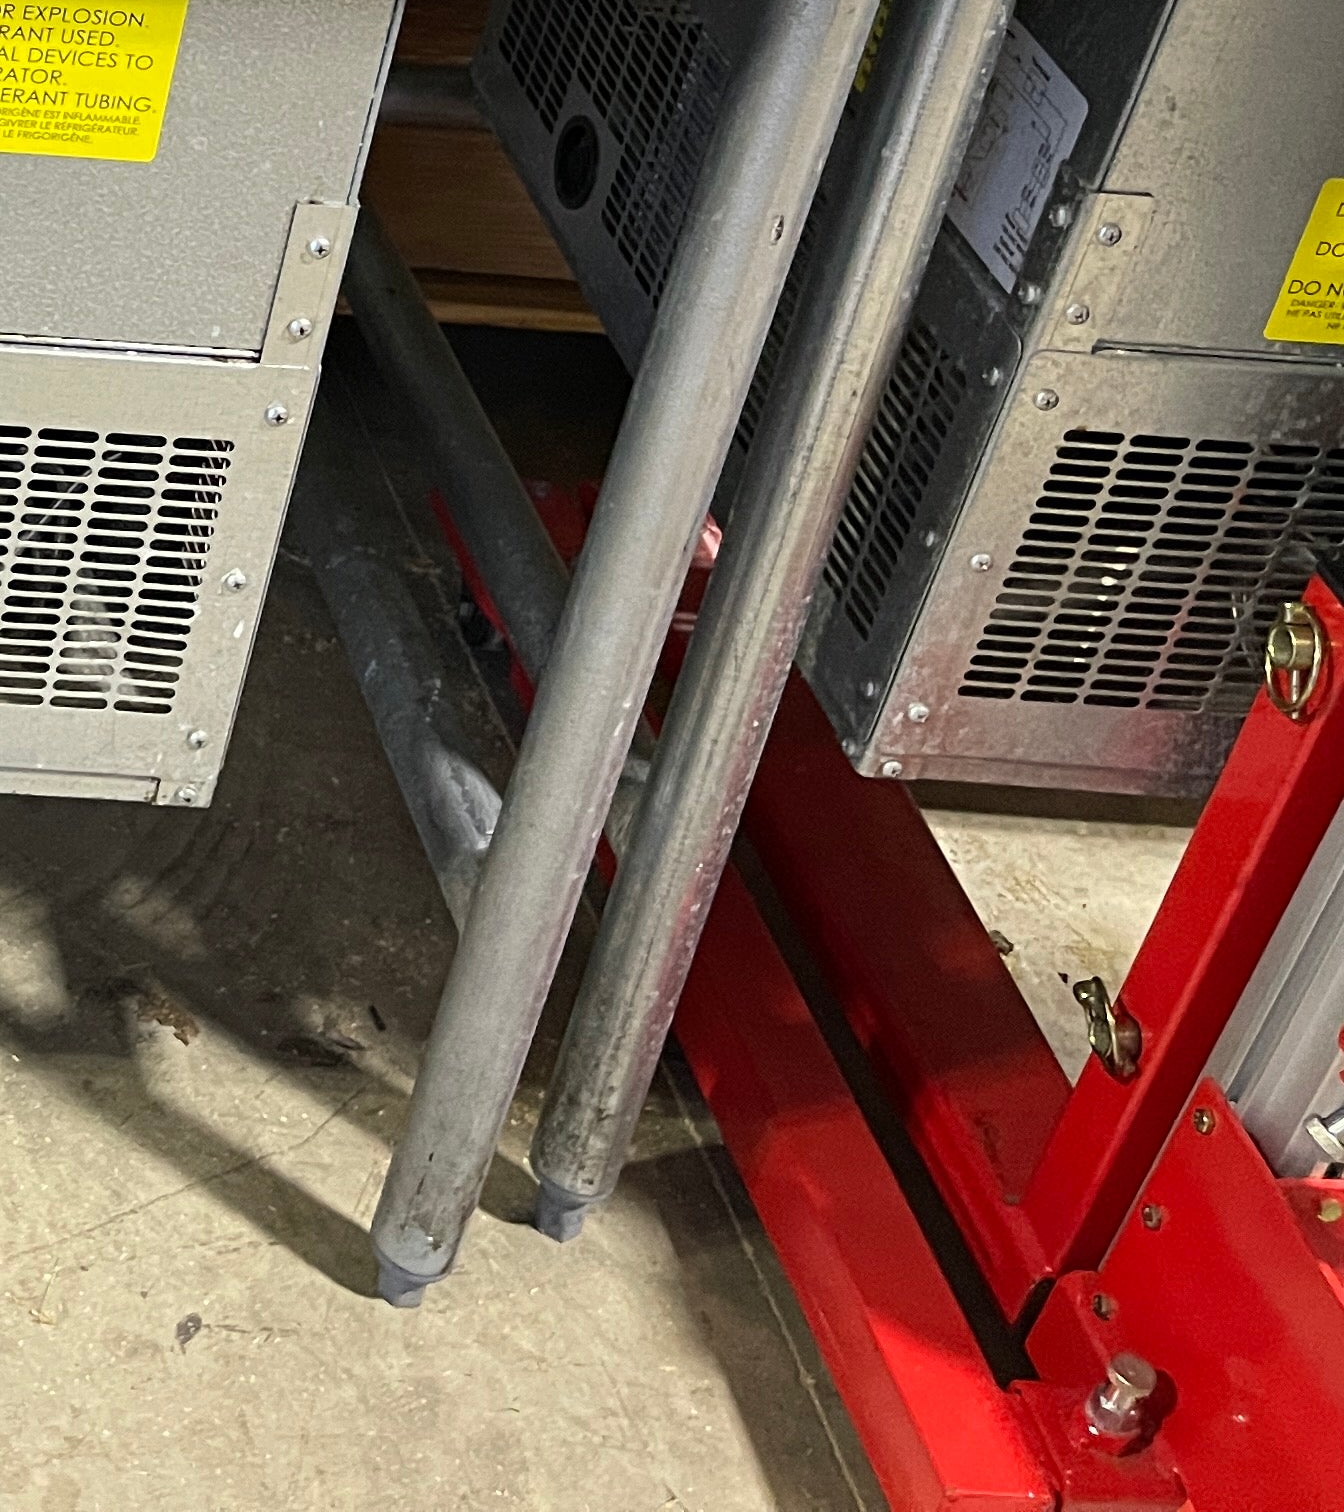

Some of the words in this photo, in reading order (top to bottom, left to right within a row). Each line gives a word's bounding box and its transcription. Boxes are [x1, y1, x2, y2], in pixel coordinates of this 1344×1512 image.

[23, 5, 150, 28] EXPLOSION.
[61, 29, 120, 47] USED.
[27, 47, 118, 69] DEVICES
[126, 54, 154, 70] TO
[75, 92, 156, 114] TUBING.
[44, 110, 61, 121] EST
[3, 129, 14, 138] LE
[39, 121, 52, 130] LE
[1288, 280, 1321, 296] DO
